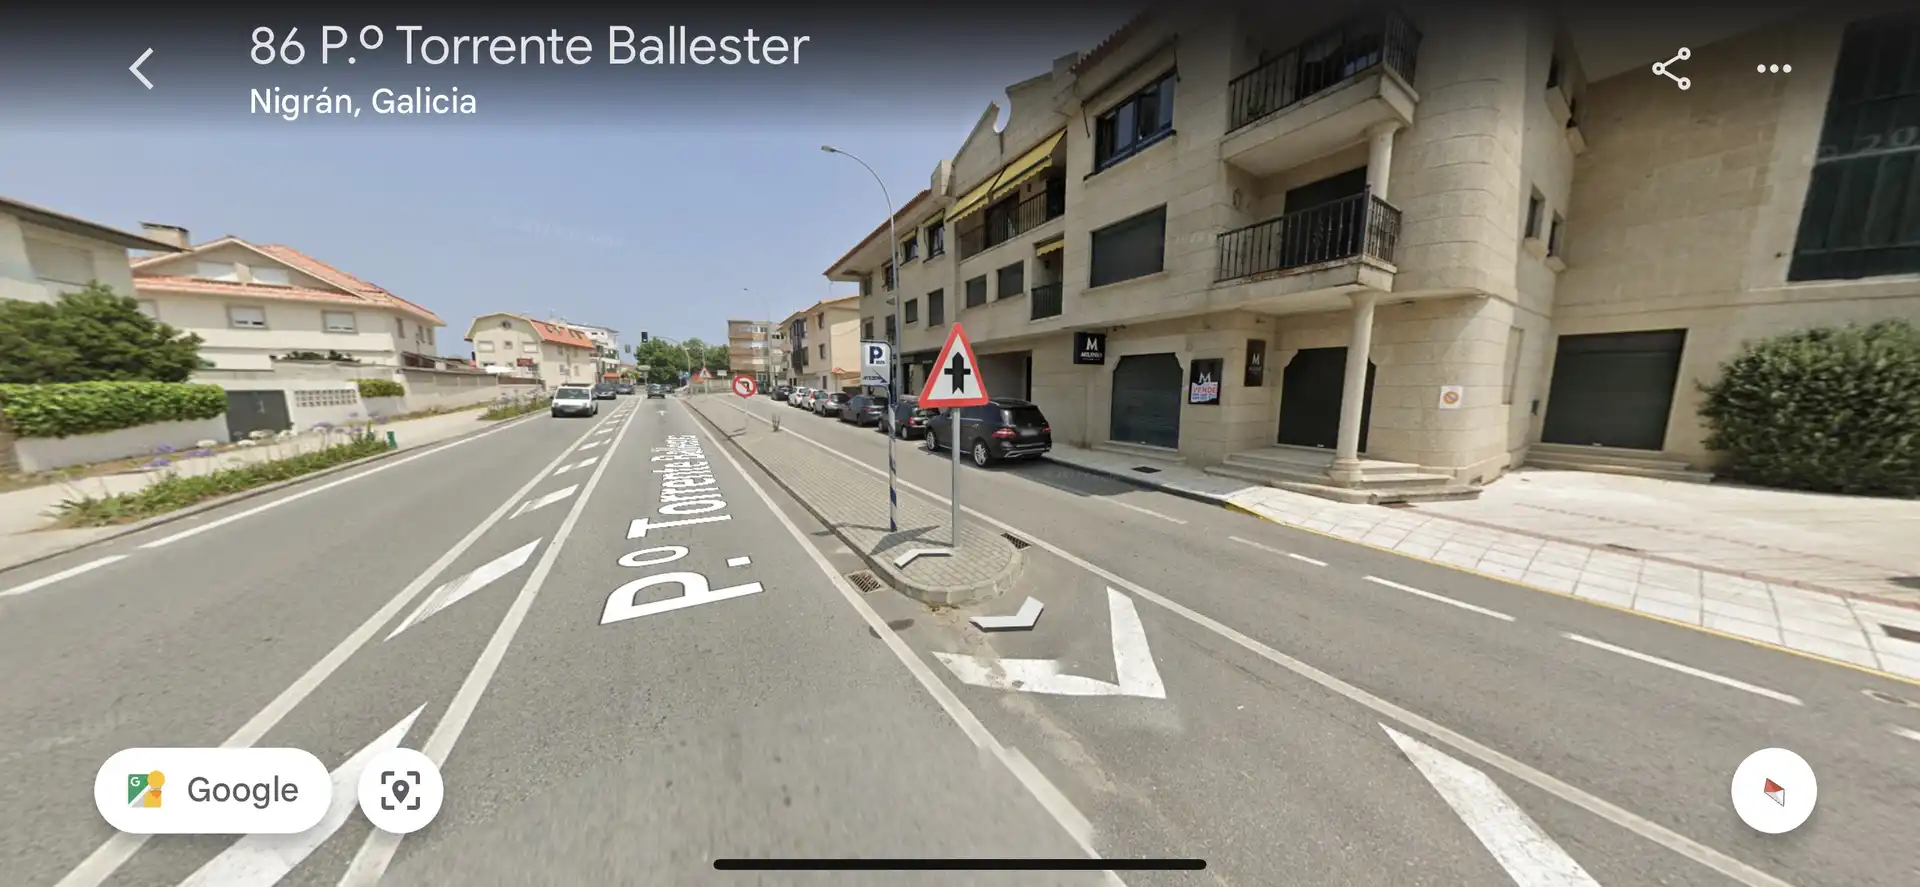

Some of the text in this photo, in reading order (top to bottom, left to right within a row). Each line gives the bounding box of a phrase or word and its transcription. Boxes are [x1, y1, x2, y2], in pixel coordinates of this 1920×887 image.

[1085, 337, 1098, 351] M
[869, 345, 883, 364] P
[1198, 371, 1212, 384] M
[1192, 386, 1217, 394] VENDE
